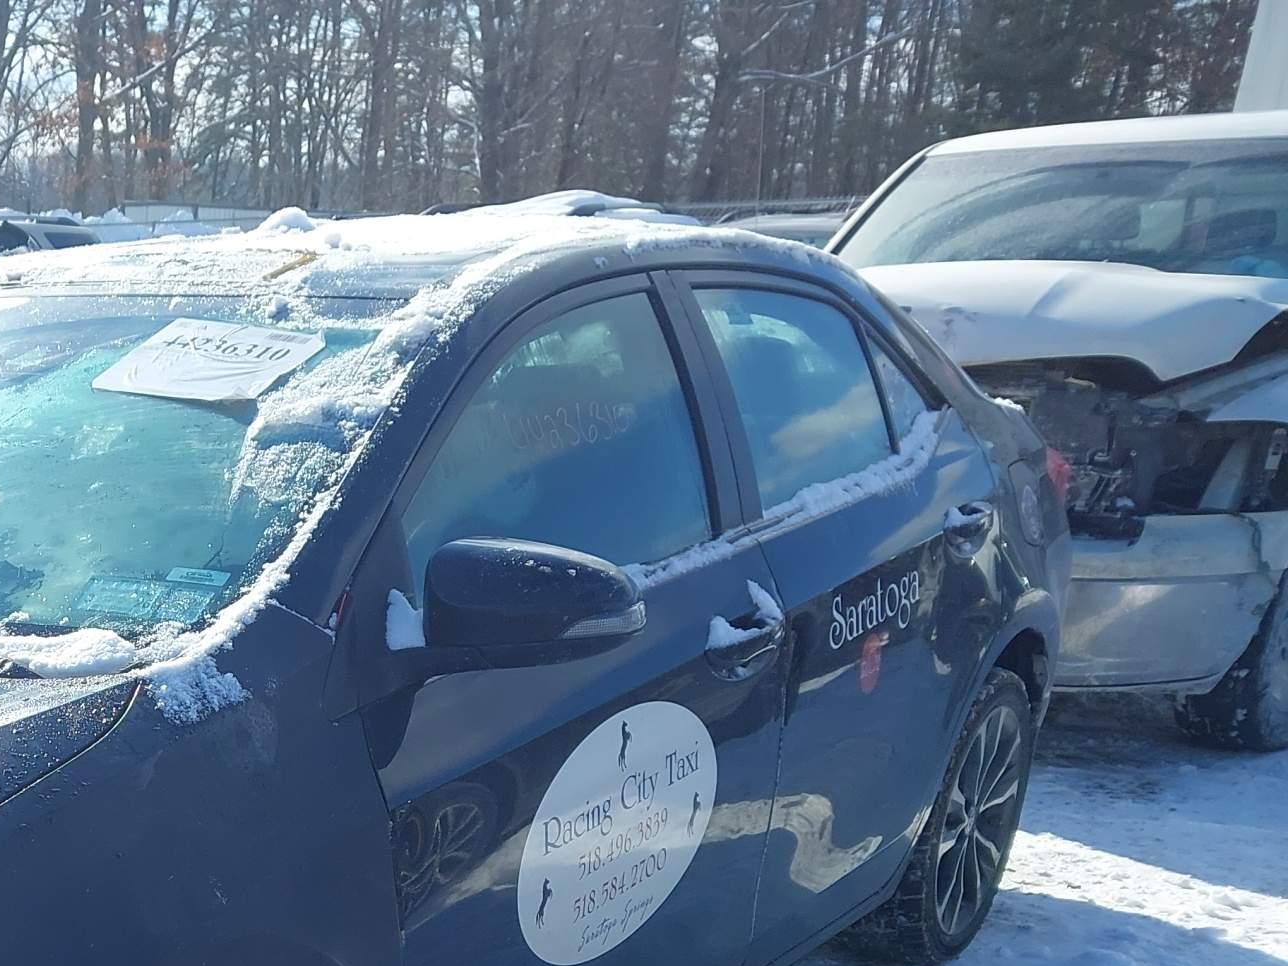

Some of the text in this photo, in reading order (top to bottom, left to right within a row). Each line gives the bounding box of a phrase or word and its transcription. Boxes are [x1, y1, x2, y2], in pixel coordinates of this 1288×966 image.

[161, 334, 291, 361] 44236310
[830, 570, 920, 649] Saratoga
[542, 741, 700, 856] Racing City Taxi
[577, 807, 669, 881] 518.496.3839
[572, 847, 668, 919] 518.584.2700
